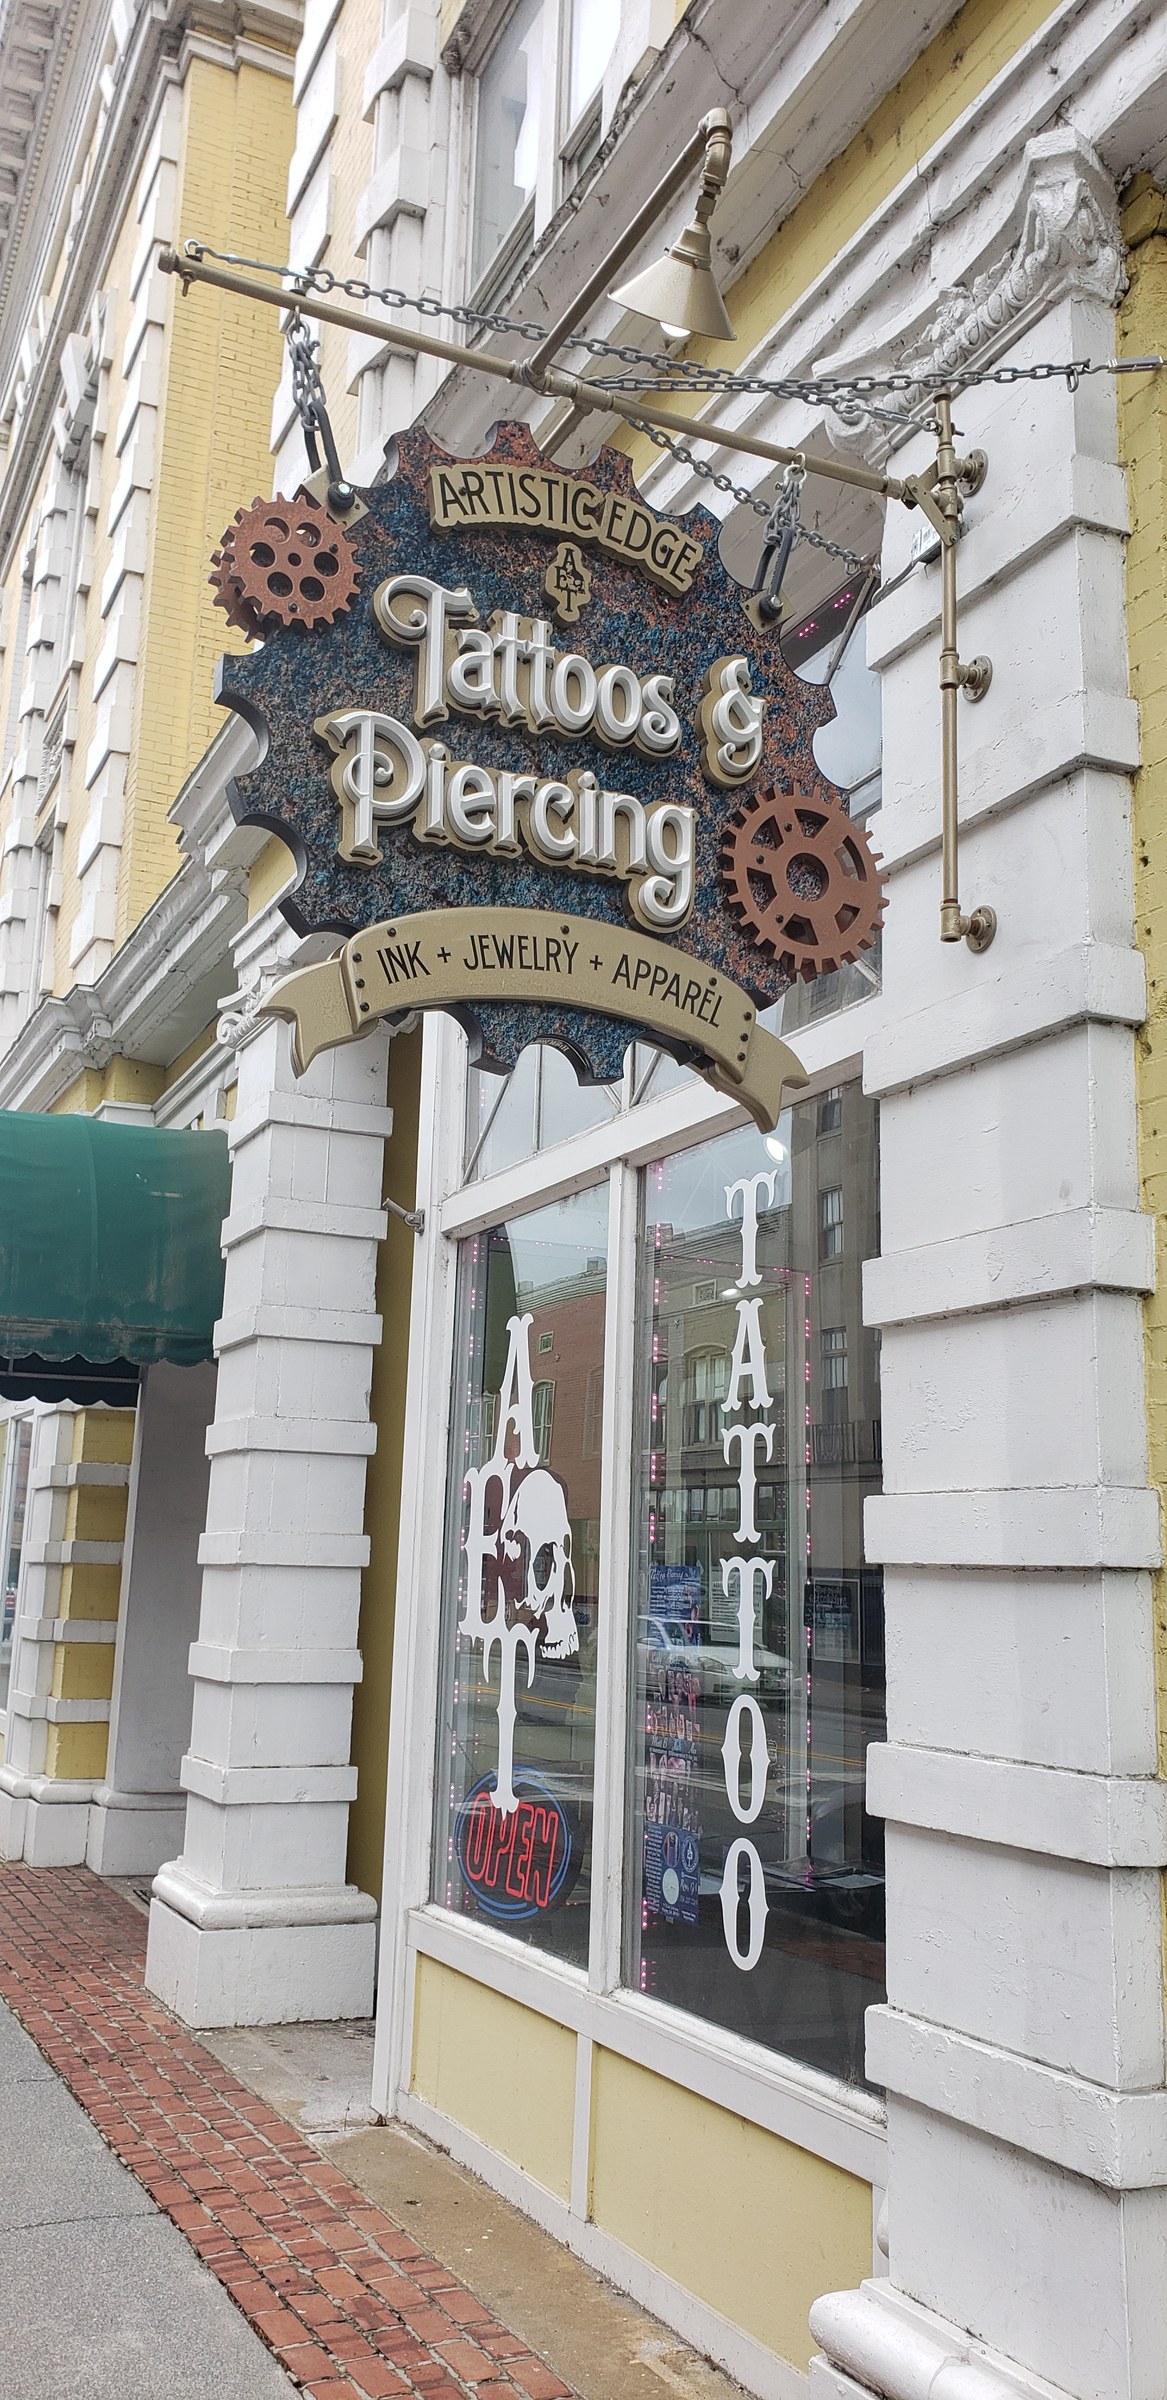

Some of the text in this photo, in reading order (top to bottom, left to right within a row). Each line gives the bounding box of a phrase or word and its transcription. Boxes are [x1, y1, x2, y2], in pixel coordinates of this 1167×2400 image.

[438, 470, 698, 584] ARTISTIC EDGE
[383, 574, 767, 774] Tattoos &
[325, 710, 696, 925] Piercing
[376, 940, 432, 985] INK
[463, 933, 580, 975] JEWELRY
[611, 953, 724, 1029] APPAREL
[718, 1169, 778, 1972] TATTOO
[466, 1791, 559, 1908] OPEN
